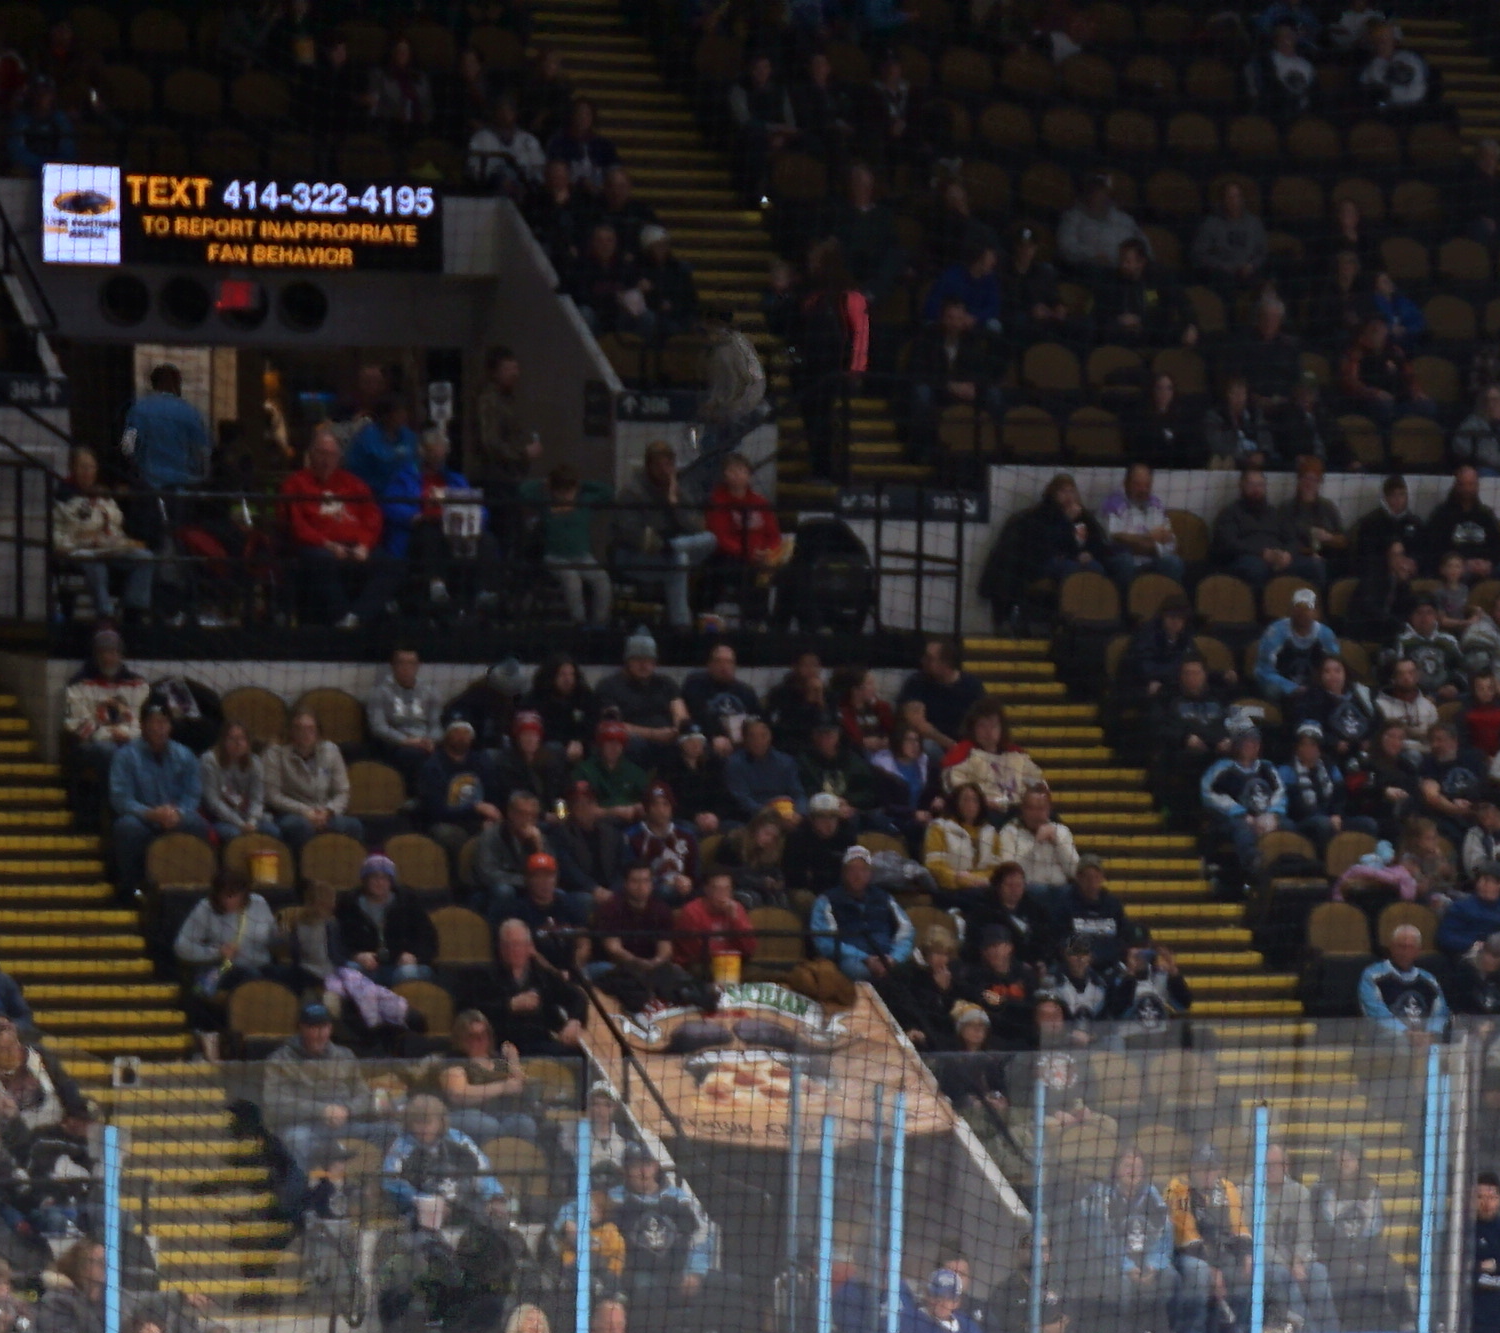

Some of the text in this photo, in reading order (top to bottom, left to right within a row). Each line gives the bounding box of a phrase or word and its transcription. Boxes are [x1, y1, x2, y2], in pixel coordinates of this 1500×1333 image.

[126, 175, 434, 216] TEXT 414-322-4195
[143, 215, 170, 235] TO
[175, 216, 255, 238] REPORT
[260, 220, 418, 244] INAPPROPRIATE
[207, 245, 354, 266] FAN BEHAVIOR
